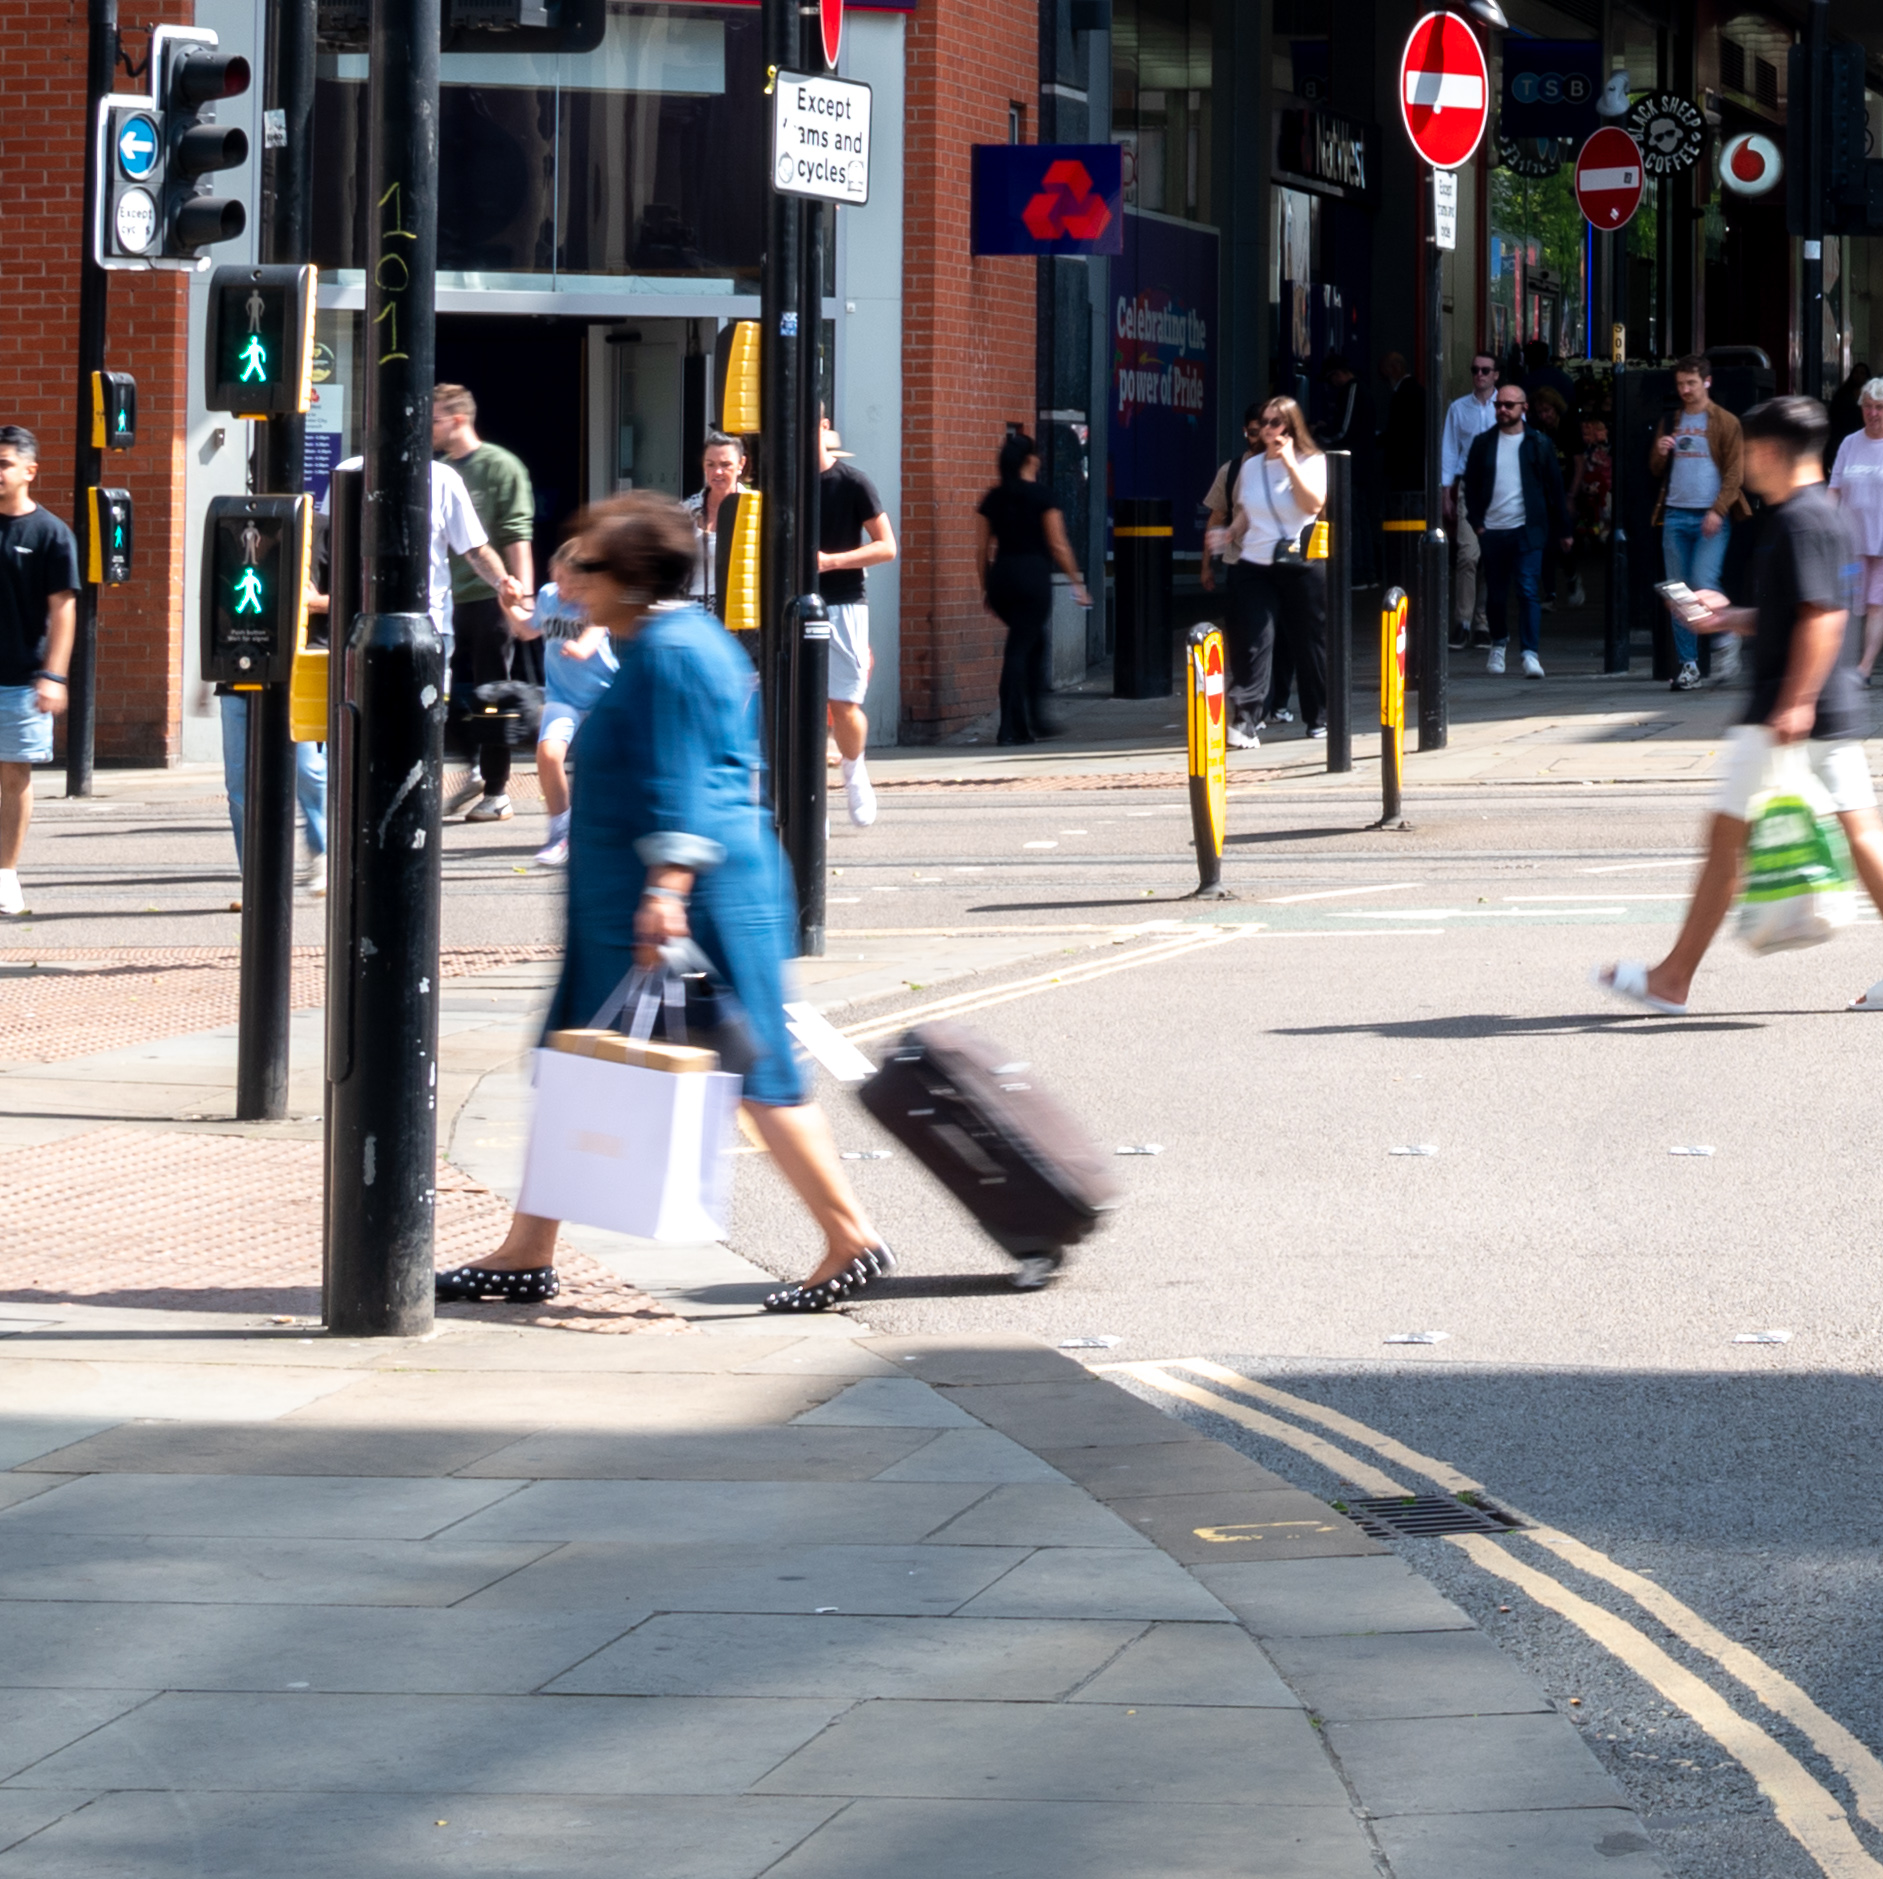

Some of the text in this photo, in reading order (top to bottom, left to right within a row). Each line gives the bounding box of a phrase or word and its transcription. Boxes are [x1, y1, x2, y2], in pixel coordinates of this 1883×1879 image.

[797, 87, 851, 121] Except
[1521, 79, 1584, 98] TSB
[1628, 95, 1702, 142] BLACK SHEEP
[834, 131, 863, 154] and
[1645, 142, 1700, 174] COFFEE
[797, 158, 846, 183] cycles
[121, 225, 150, 236] cycs
[1117, 296, 1206, 357] Celebrating the
[1118, 364, 1204, 411] power of Pride
